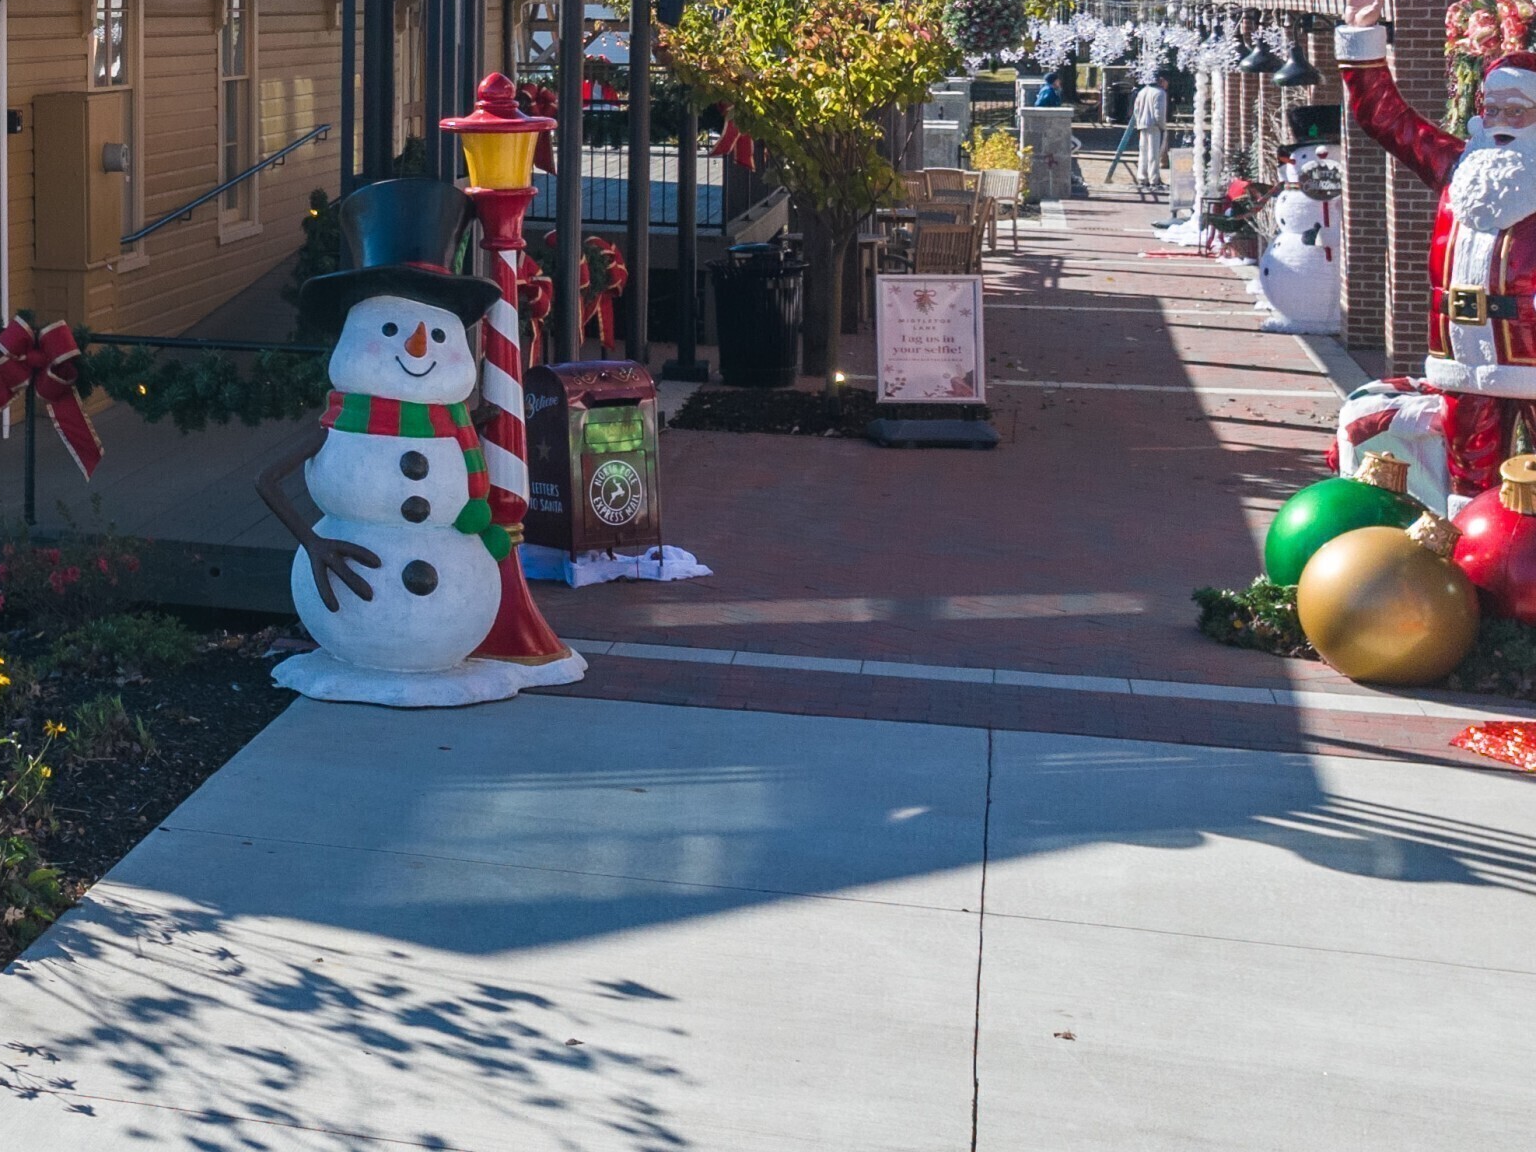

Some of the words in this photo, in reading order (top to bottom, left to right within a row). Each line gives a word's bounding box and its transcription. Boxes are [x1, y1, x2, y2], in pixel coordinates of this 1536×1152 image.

[942, 334, 955, 343] in
[892, 347, 921, 355] your
[620, 465, 638, 485] POLE
[531, 482, 560, 497] LETTERS
[540, 498, 563, 513] SANTA
[593, 496, 624, 522] EXPRESS
[625, 493, 640, 516] MAIL
